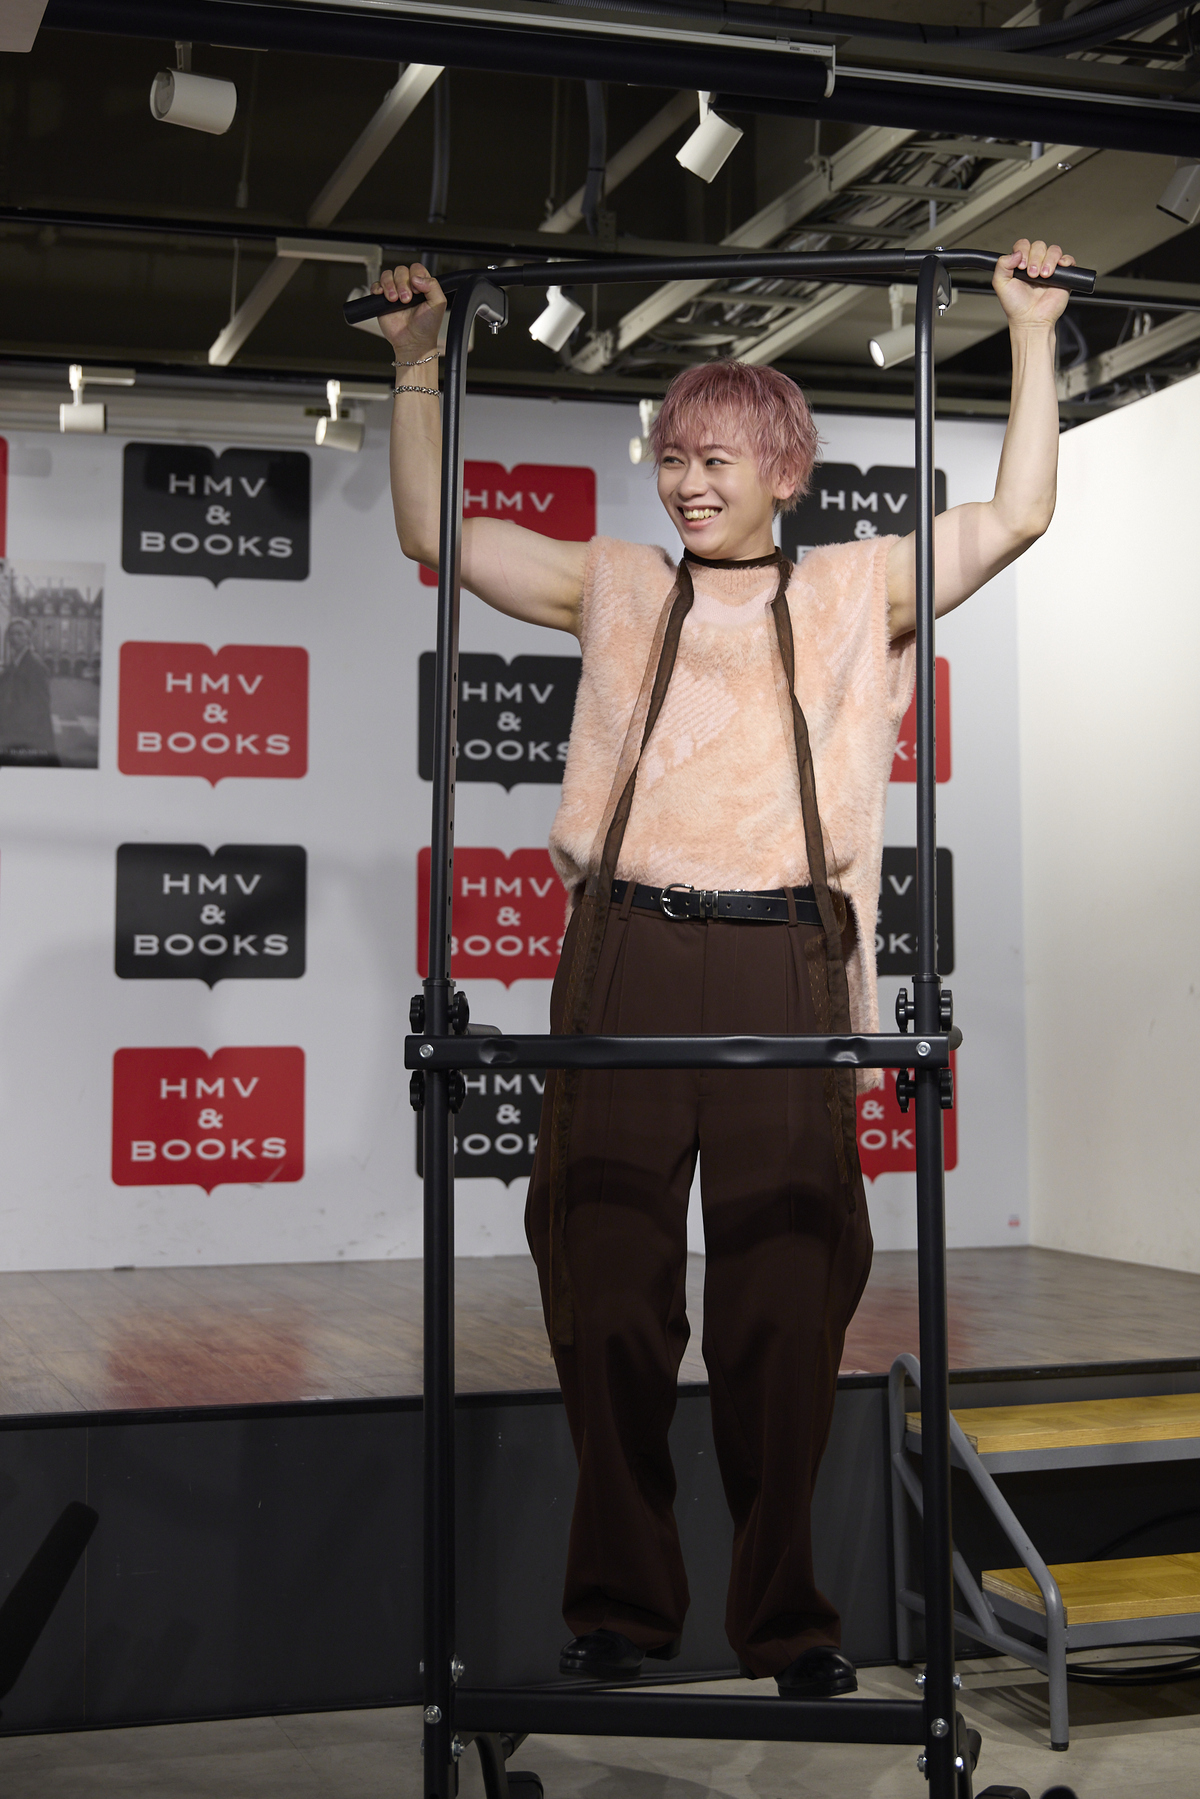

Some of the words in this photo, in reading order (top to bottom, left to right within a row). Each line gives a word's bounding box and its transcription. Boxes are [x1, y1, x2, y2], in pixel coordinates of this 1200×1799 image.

[169, 474, 266, 498] HMV
[464, 488, 554, 513] HMV
[821, 489, 908, 514] HMV
[205, 505, 231, 525] &
[854, 519, 878, 538] &
[140, 531, 293, 558] BOOKS
[166, 672, 263, 695] HMV
[462, 681, 554, 704] HMV
[203, 703, 228, 724] &
[497, 711, 521, 732] &
[136, 731, 291, 755] BOOKS
[162, 873, 261, 895] HMV
[461, 876, 553, 898] HMV
[200, 904, 226, 925] &
[497, 906, 521, 926] &
[134, 933, 289, 956] BOOKS
[451, 935, 563, 957] OOK
[160, 1076, 259, 1099] HMV
[198, 1108, 223, 1129] &
[496, 1103, 521, 1125] &
[861, 1099, 884, 1120] &
[131, 1137, 288, 1162] BOOKS
